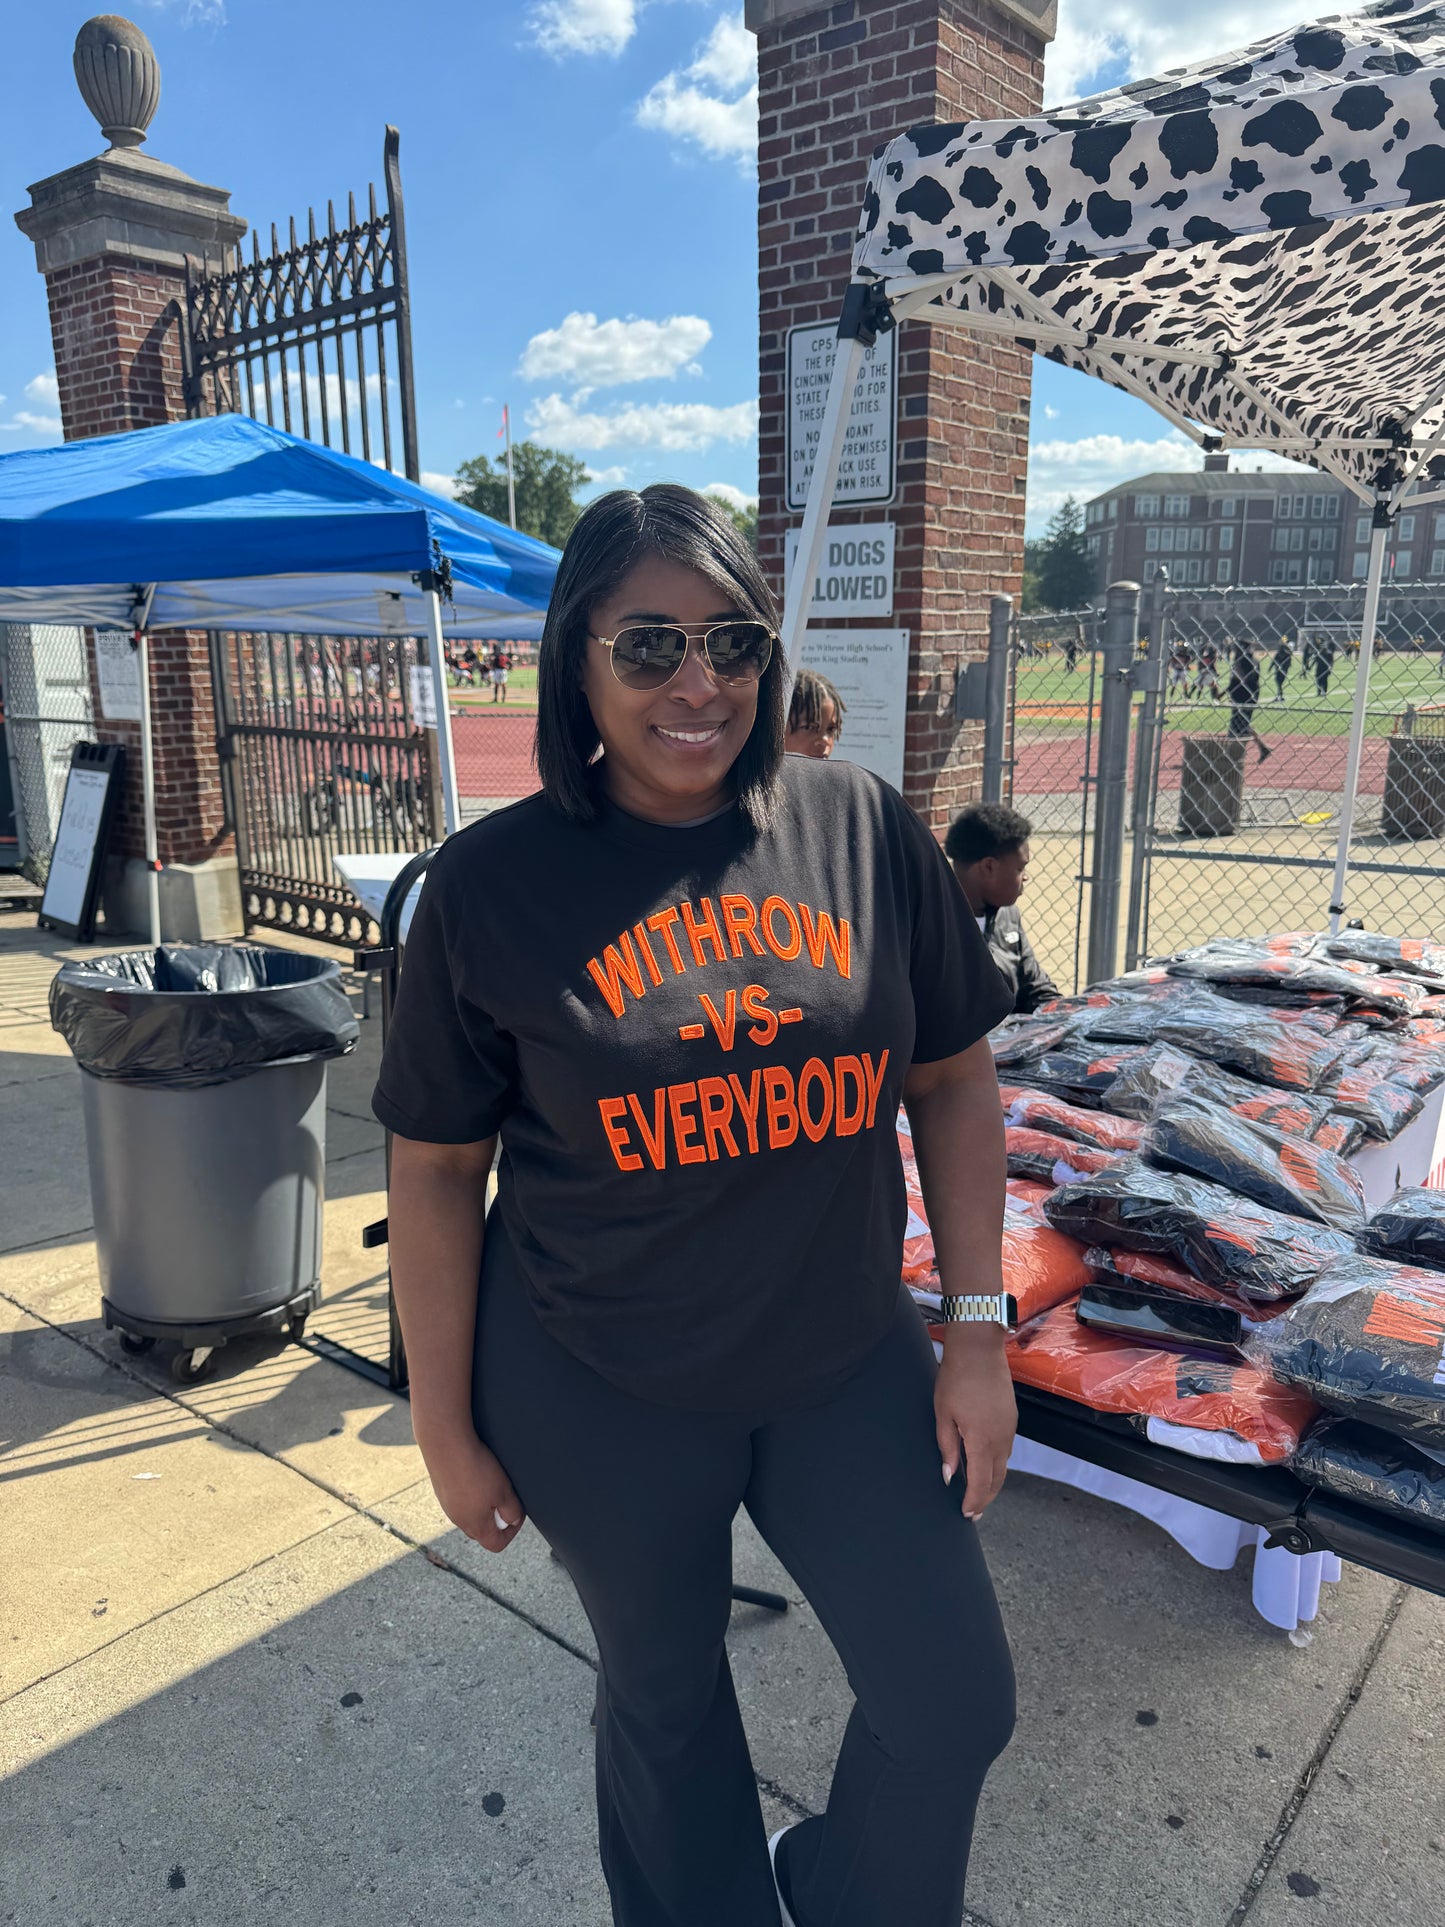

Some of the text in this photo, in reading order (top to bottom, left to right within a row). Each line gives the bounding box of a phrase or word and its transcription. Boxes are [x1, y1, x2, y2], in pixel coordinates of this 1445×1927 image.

[811, 338, 833, 352] CPS
[805, 356, 822, 370] THE
[864, 347, 877, 361] OF
[794, 373, 833, 389] CINCINN
[871, 363, 888, 378] THE
[795, 390, 821, 406] STATE
[867, 381, 886, 396] FOR
[851, 400, 881, 415] LITIES.
[793, 448, 806, 462] ON
[842, 440, 887, 456] PREMISES
[858, 458, 876, 471] USE
[795, 482, 805, 494] AT
[829, 539, 885, 567] DOGS
[812, 575, 887, 602] LOWED
[586, 893, 850, 1019] WITHROW
[598, 1049, 889, 1171] EVERYBODY
